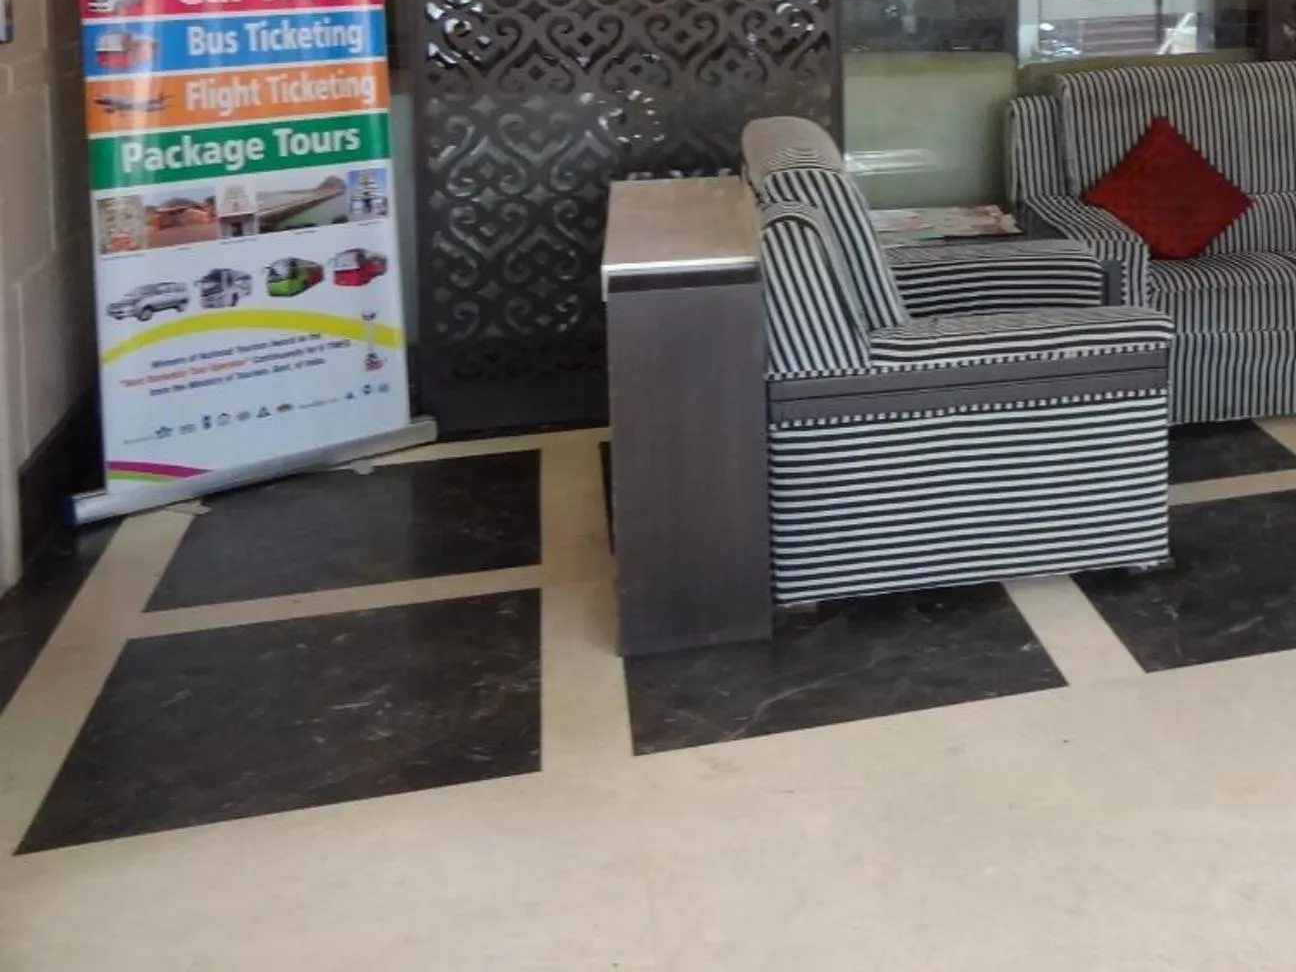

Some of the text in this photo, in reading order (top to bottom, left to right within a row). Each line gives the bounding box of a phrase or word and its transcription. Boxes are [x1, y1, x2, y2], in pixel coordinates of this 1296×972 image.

[188, 18, 363, 55] Bus Ticketing
[185, 70, 377, 116] Flight Ticketing
[121, 127, 360, 173] Package Tours
